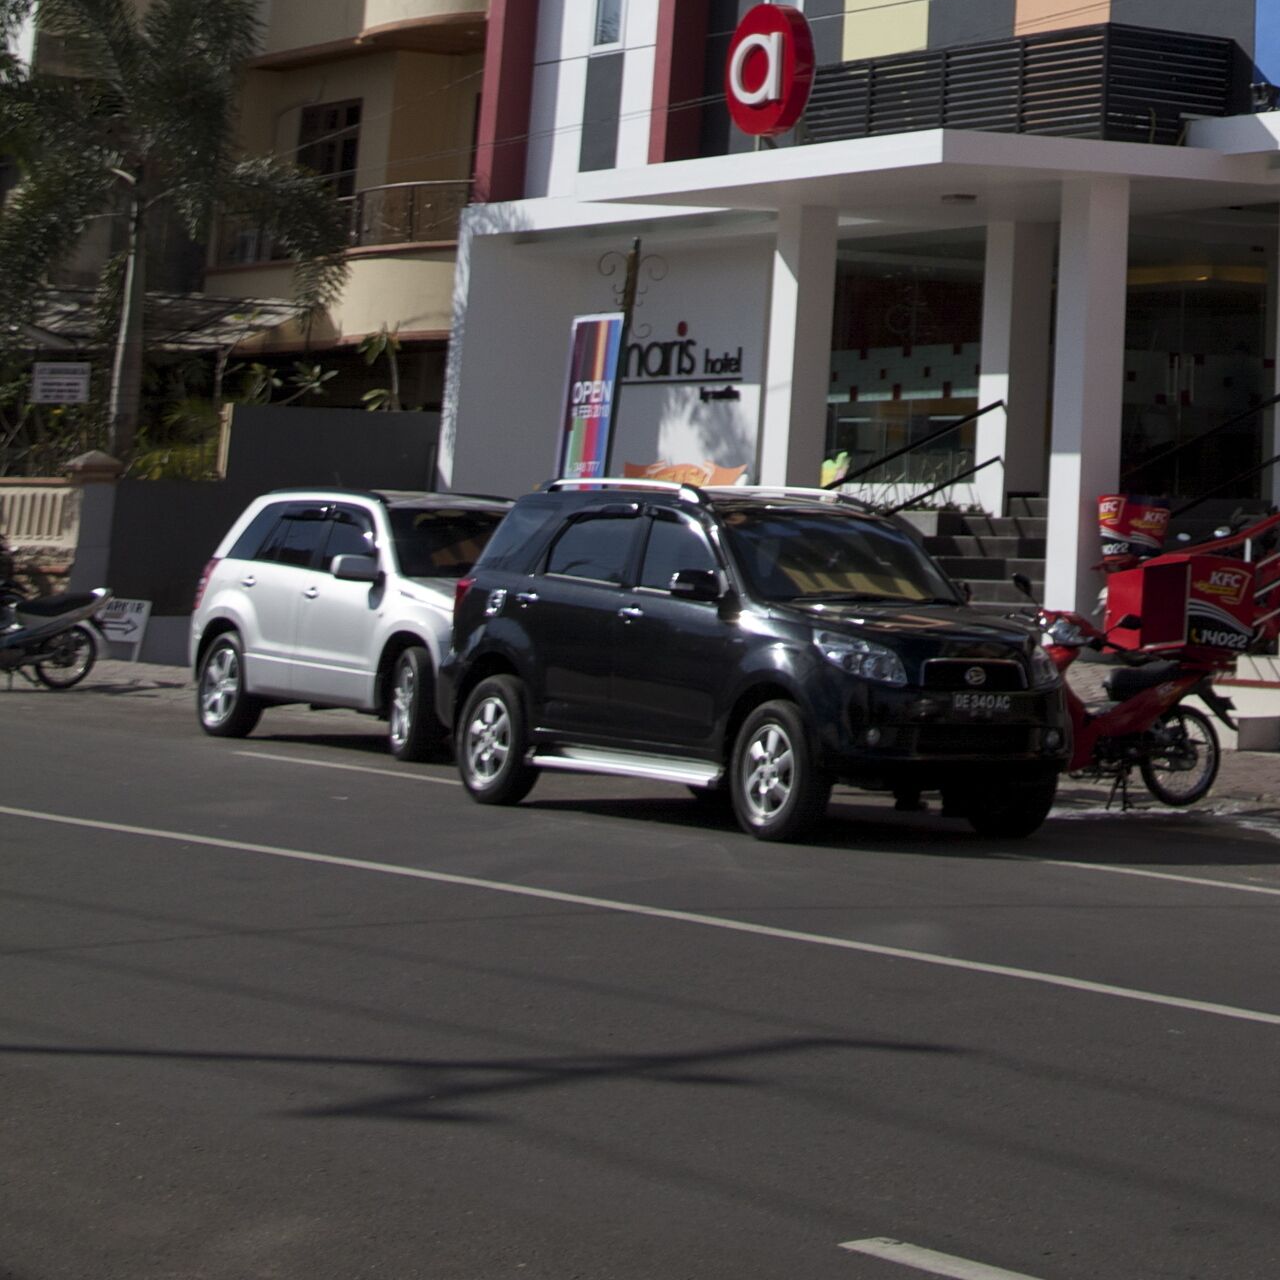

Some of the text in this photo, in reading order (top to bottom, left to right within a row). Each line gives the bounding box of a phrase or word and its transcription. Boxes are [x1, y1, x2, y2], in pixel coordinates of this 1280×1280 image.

[622, 321, 743, 378] maris hotel
[572, 380, 613, 405] OPEN
[1144, 511, 1168, 524] KFC
[1210, 571, 1242, 588] KFC
[106, 600, 145, 615] ARKIR
[1201, 629, 1248, 648] 14022
